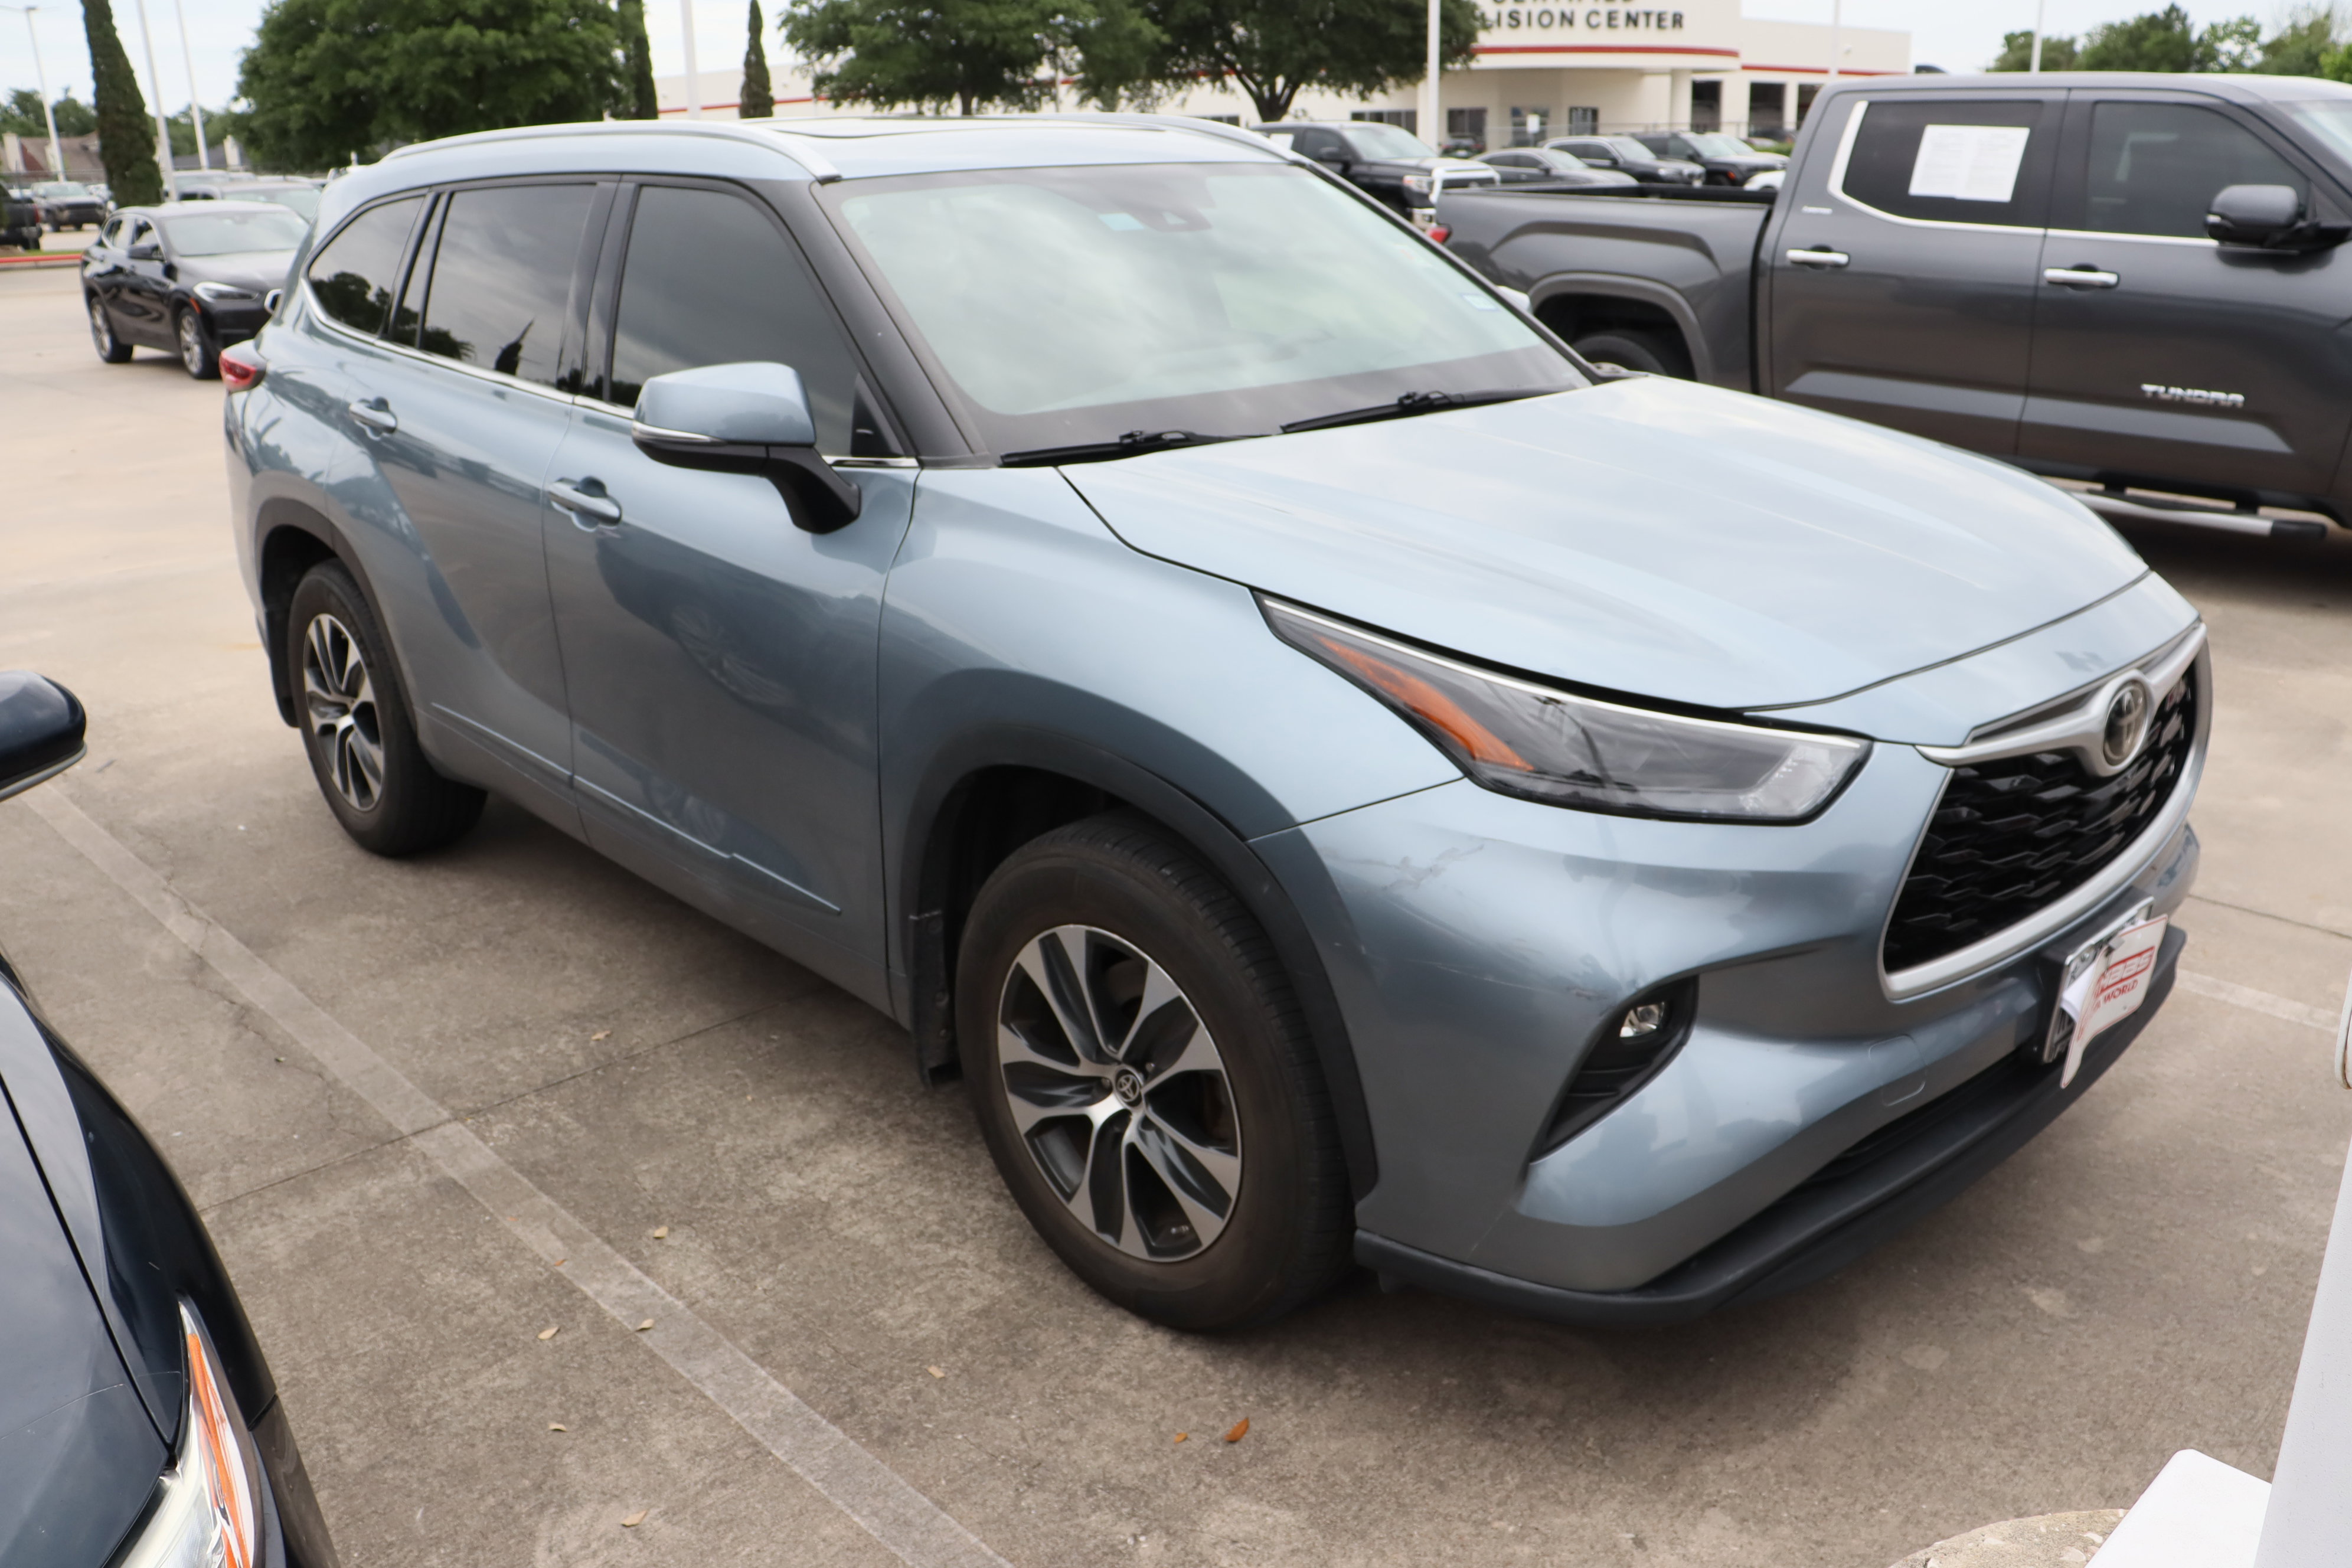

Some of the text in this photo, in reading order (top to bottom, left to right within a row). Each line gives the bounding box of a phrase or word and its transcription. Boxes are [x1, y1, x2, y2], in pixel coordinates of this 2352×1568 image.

[1481, 9, 1684, 28] LISION CENTER
[2141, 384, 2245, 407] TUNDRA
[2103, 979, 2138, 1004] WORLD
